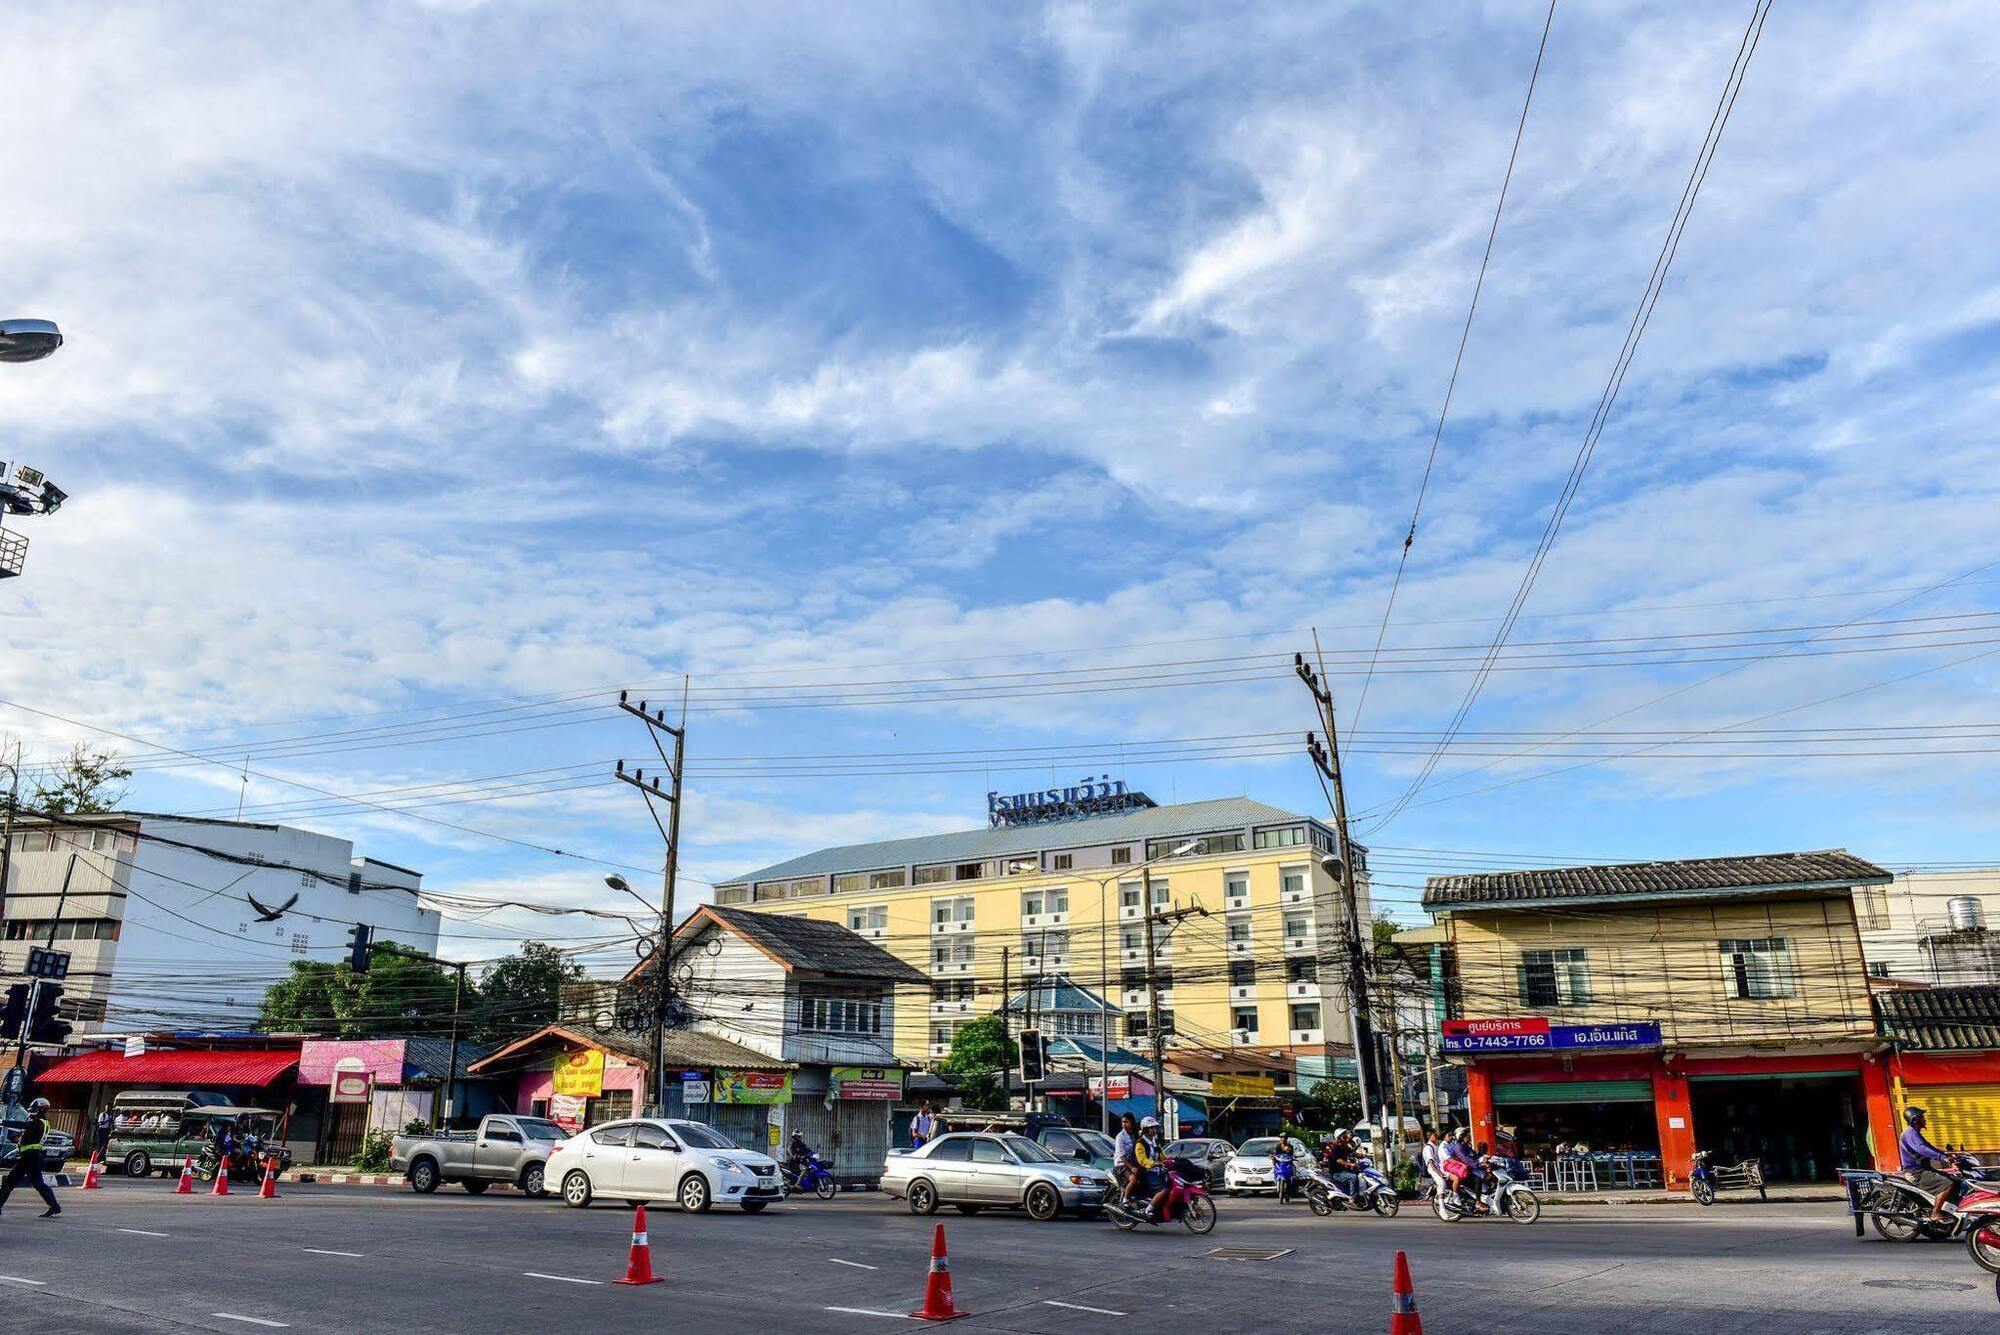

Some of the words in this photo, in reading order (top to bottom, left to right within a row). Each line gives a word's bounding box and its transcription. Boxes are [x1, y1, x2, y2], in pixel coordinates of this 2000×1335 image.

[1468, 1019, 1521, 1034] ศูนย์บริการ
[1445, 1038, 1462, 1049] โทร.
[1463, 1034, 1545, 1048] 0-7443-7766
